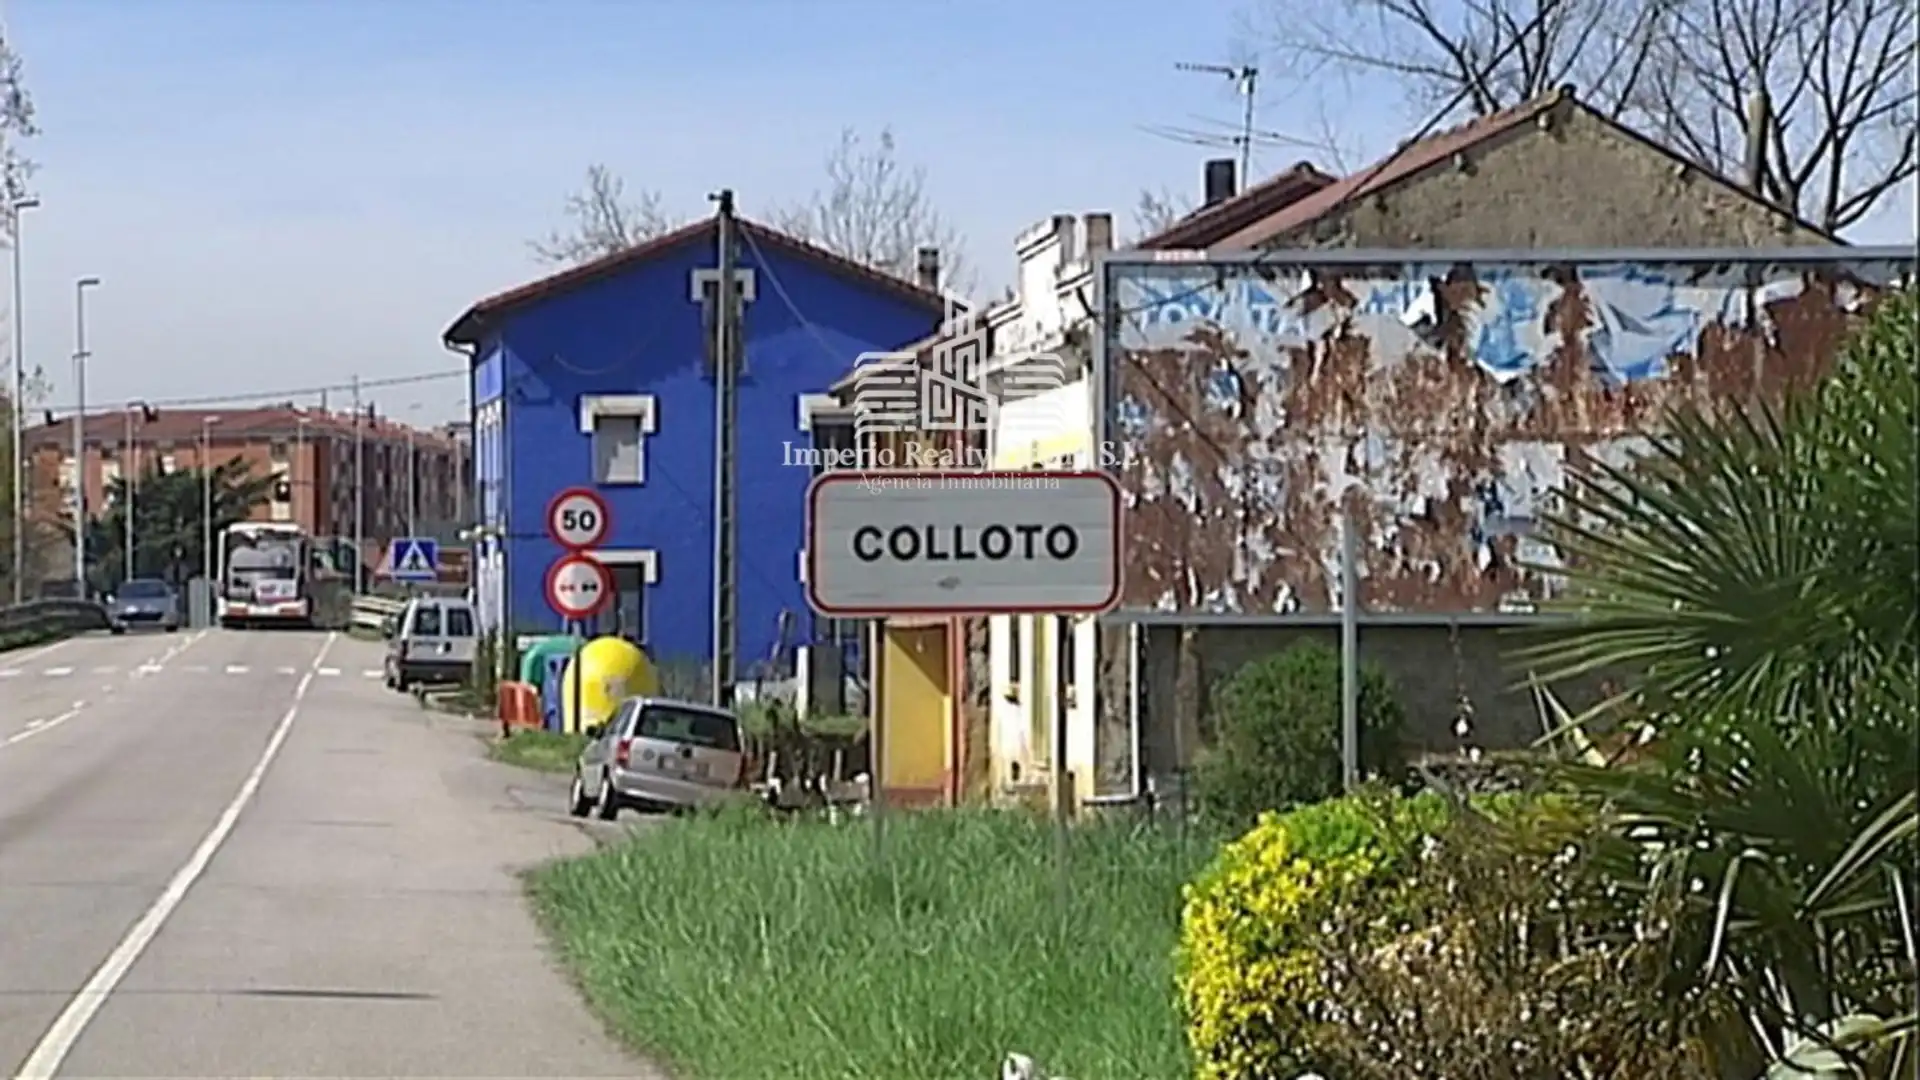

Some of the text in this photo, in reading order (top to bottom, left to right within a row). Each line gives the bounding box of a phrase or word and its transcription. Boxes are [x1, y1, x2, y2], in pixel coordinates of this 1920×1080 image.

[1138, 303, 1306, 336] TOYTA
[561, 509, 596, 532] 50
[852, 524, 1079, 562] COLLOTO
